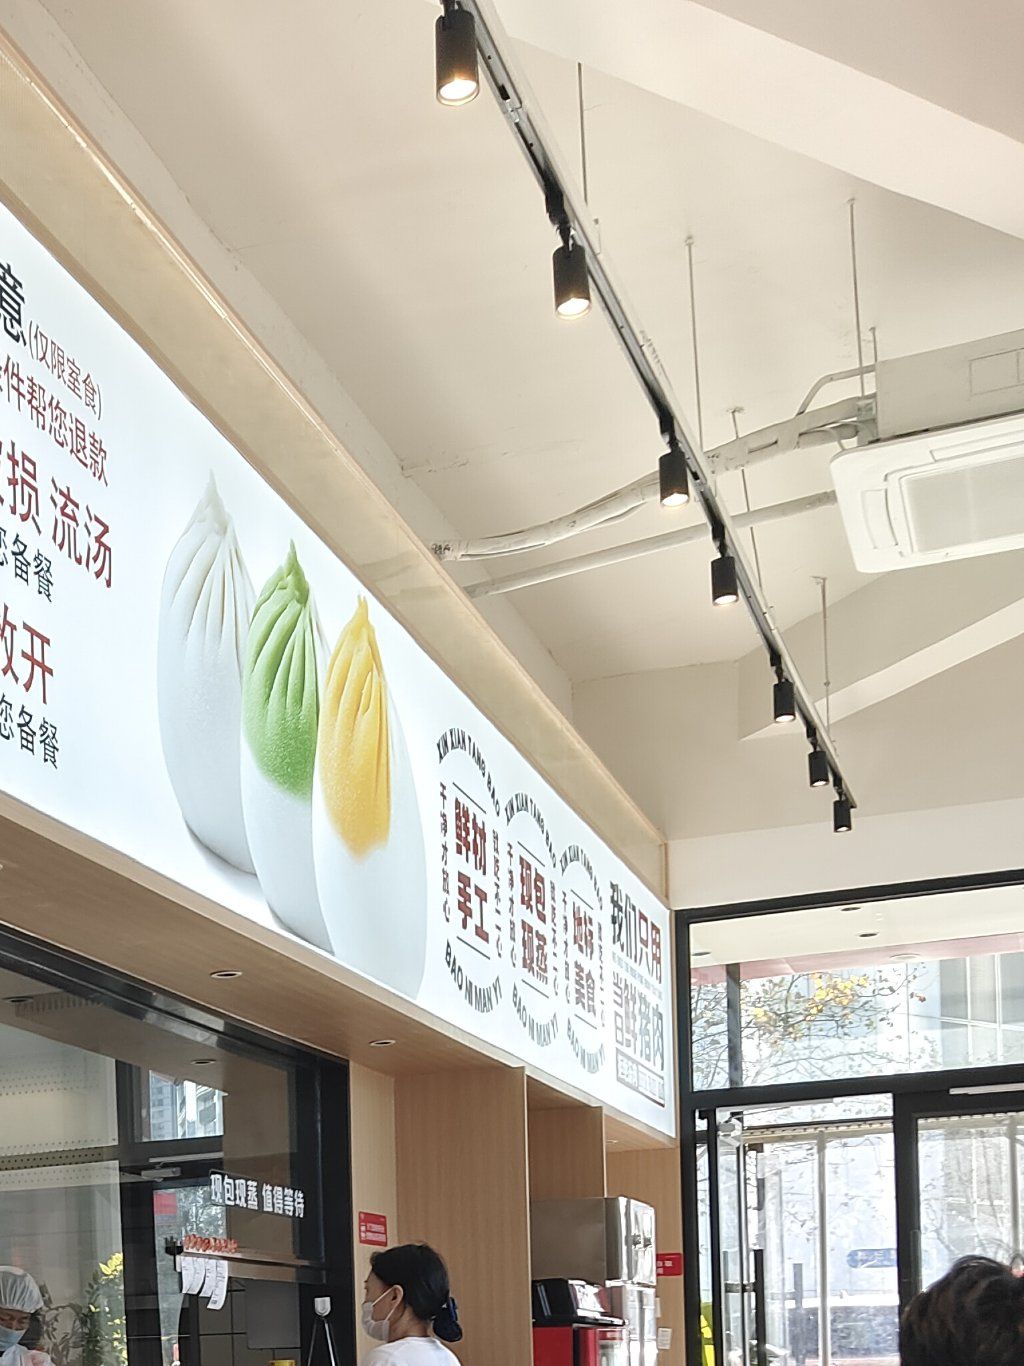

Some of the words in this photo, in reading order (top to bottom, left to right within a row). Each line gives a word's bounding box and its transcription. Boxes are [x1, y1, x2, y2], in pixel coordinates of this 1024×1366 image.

[49, 476, 113, 589] 流汤
[457, 870, 490, 945] 手工
[519, 854, 547, 926] 现包
[445, 938, 464, 992] BAO
[520, 918, 549, 987] 现蒸
[609, 879, 663, 985] 我们只用
[210, 1173, 259, 1210] 现包现蒸
[261, 1182, 305, 1219] 值得等待
